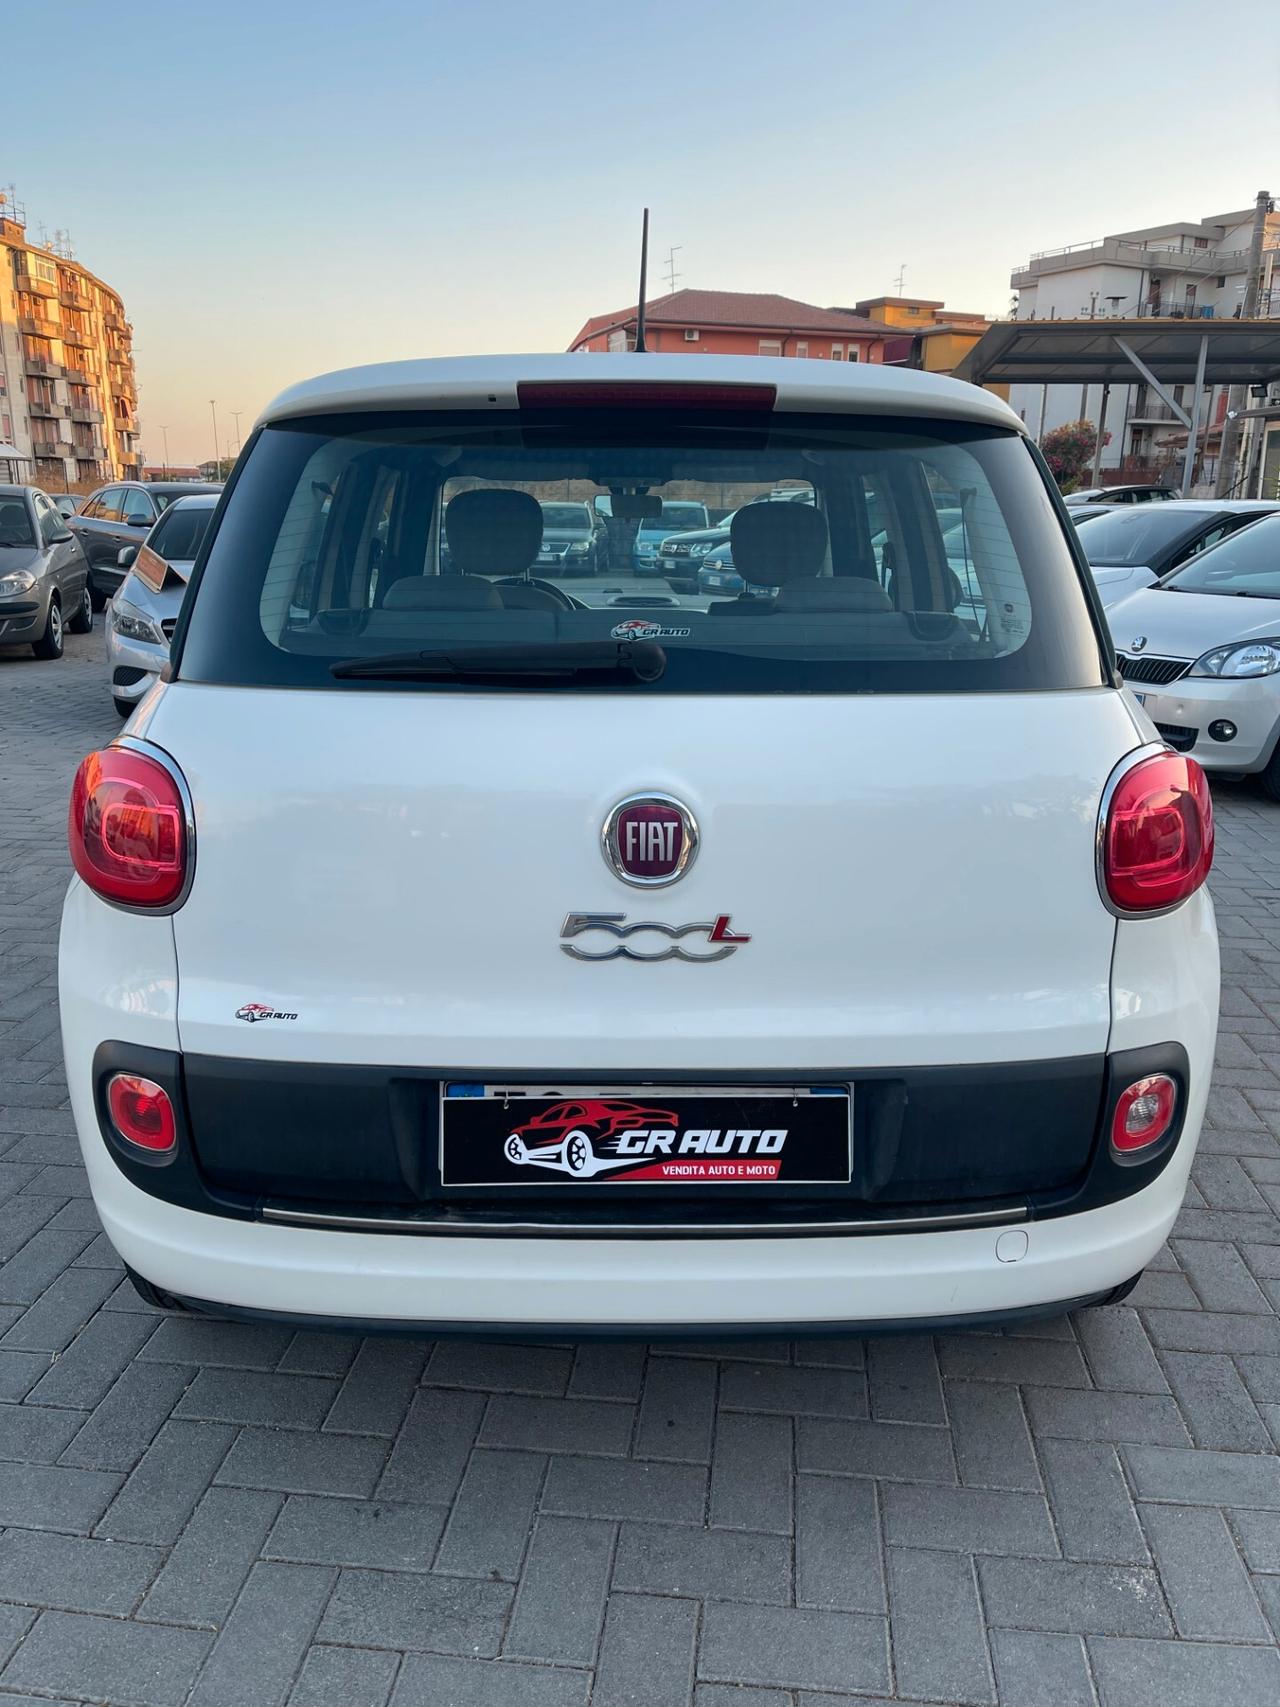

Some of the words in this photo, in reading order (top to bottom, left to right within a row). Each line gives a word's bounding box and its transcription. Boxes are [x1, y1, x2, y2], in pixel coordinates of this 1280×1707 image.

[626, 821, 679, 862] FIAT
[560, 911, 752, 963] 500L
[273, 1012, 298, 1020] AUTO
[615, 1130, 677, 1154] GR
[678, 1130, 788, 1154] AUTO
[662, 1165, 706, 1175] VENDITA
[708, 1165, 735, 1175] AUTO
[737, 1165, 744, 1175] E
[746, 1165, 776, 1175] MOTO
